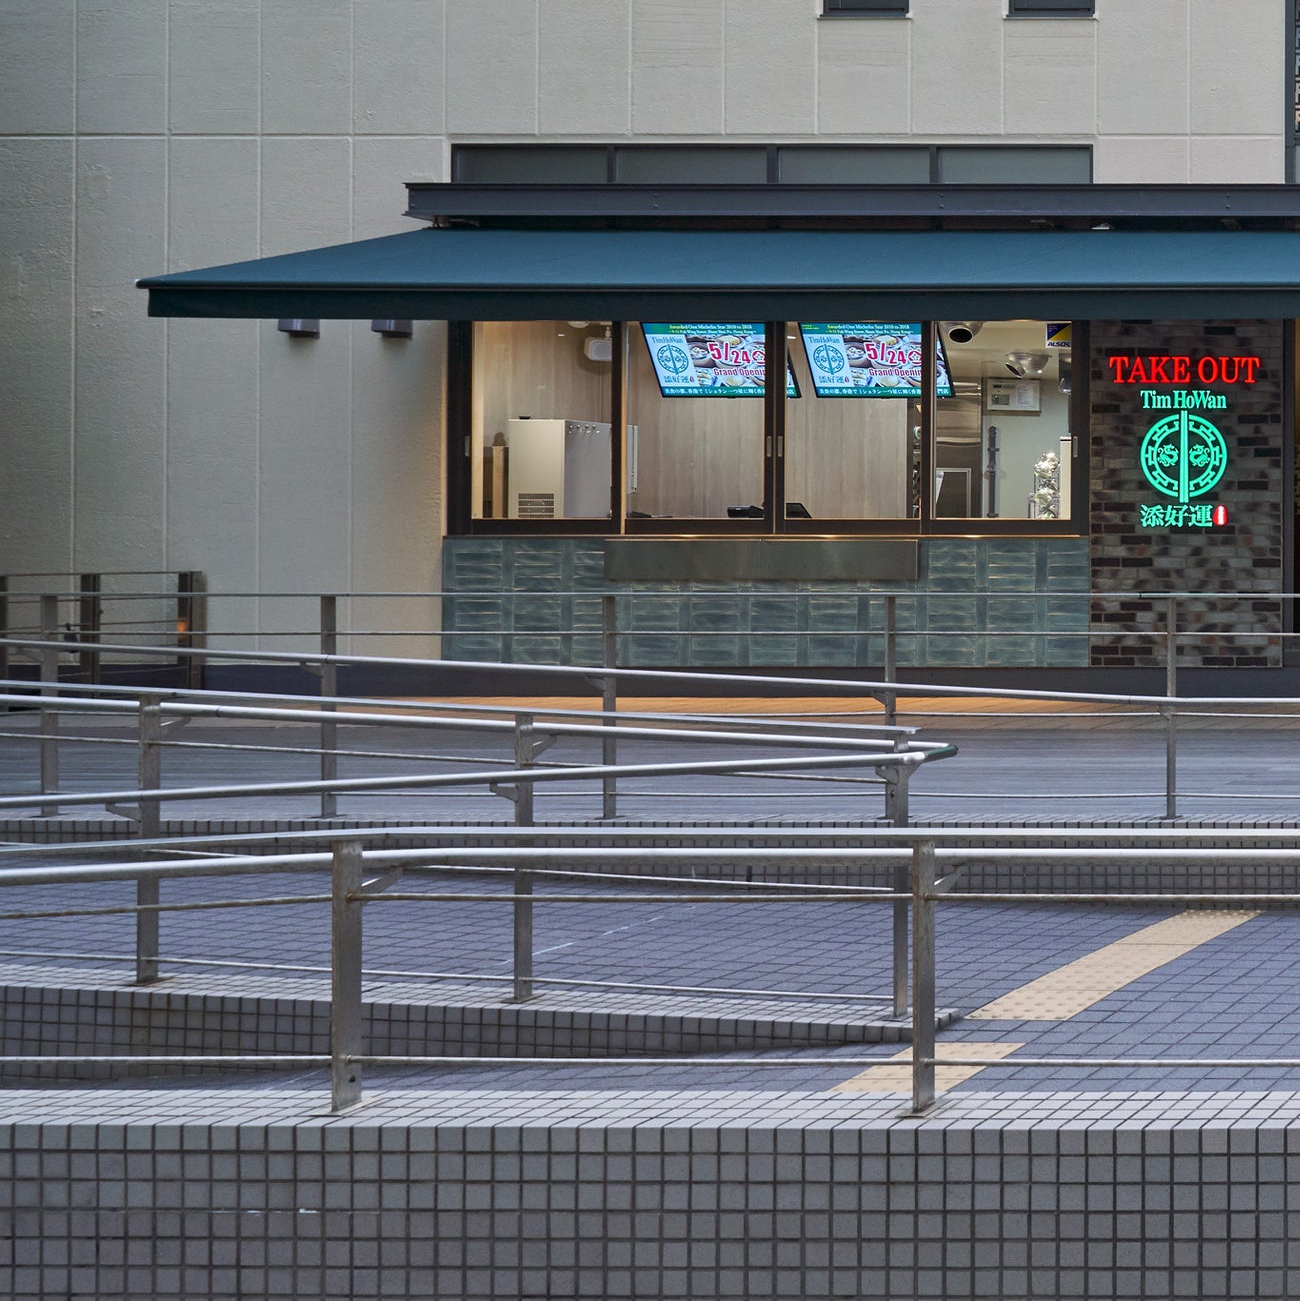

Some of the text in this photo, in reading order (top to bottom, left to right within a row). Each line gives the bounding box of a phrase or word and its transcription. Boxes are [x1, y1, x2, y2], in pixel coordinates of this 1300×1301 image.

[708, 342, 750, 364] 5/24
[865, 342, 906, 364] 5/24
[1109, 356, 1260, 384] TAKE OUT
[1140, 504, 1213, 528] 添好運
